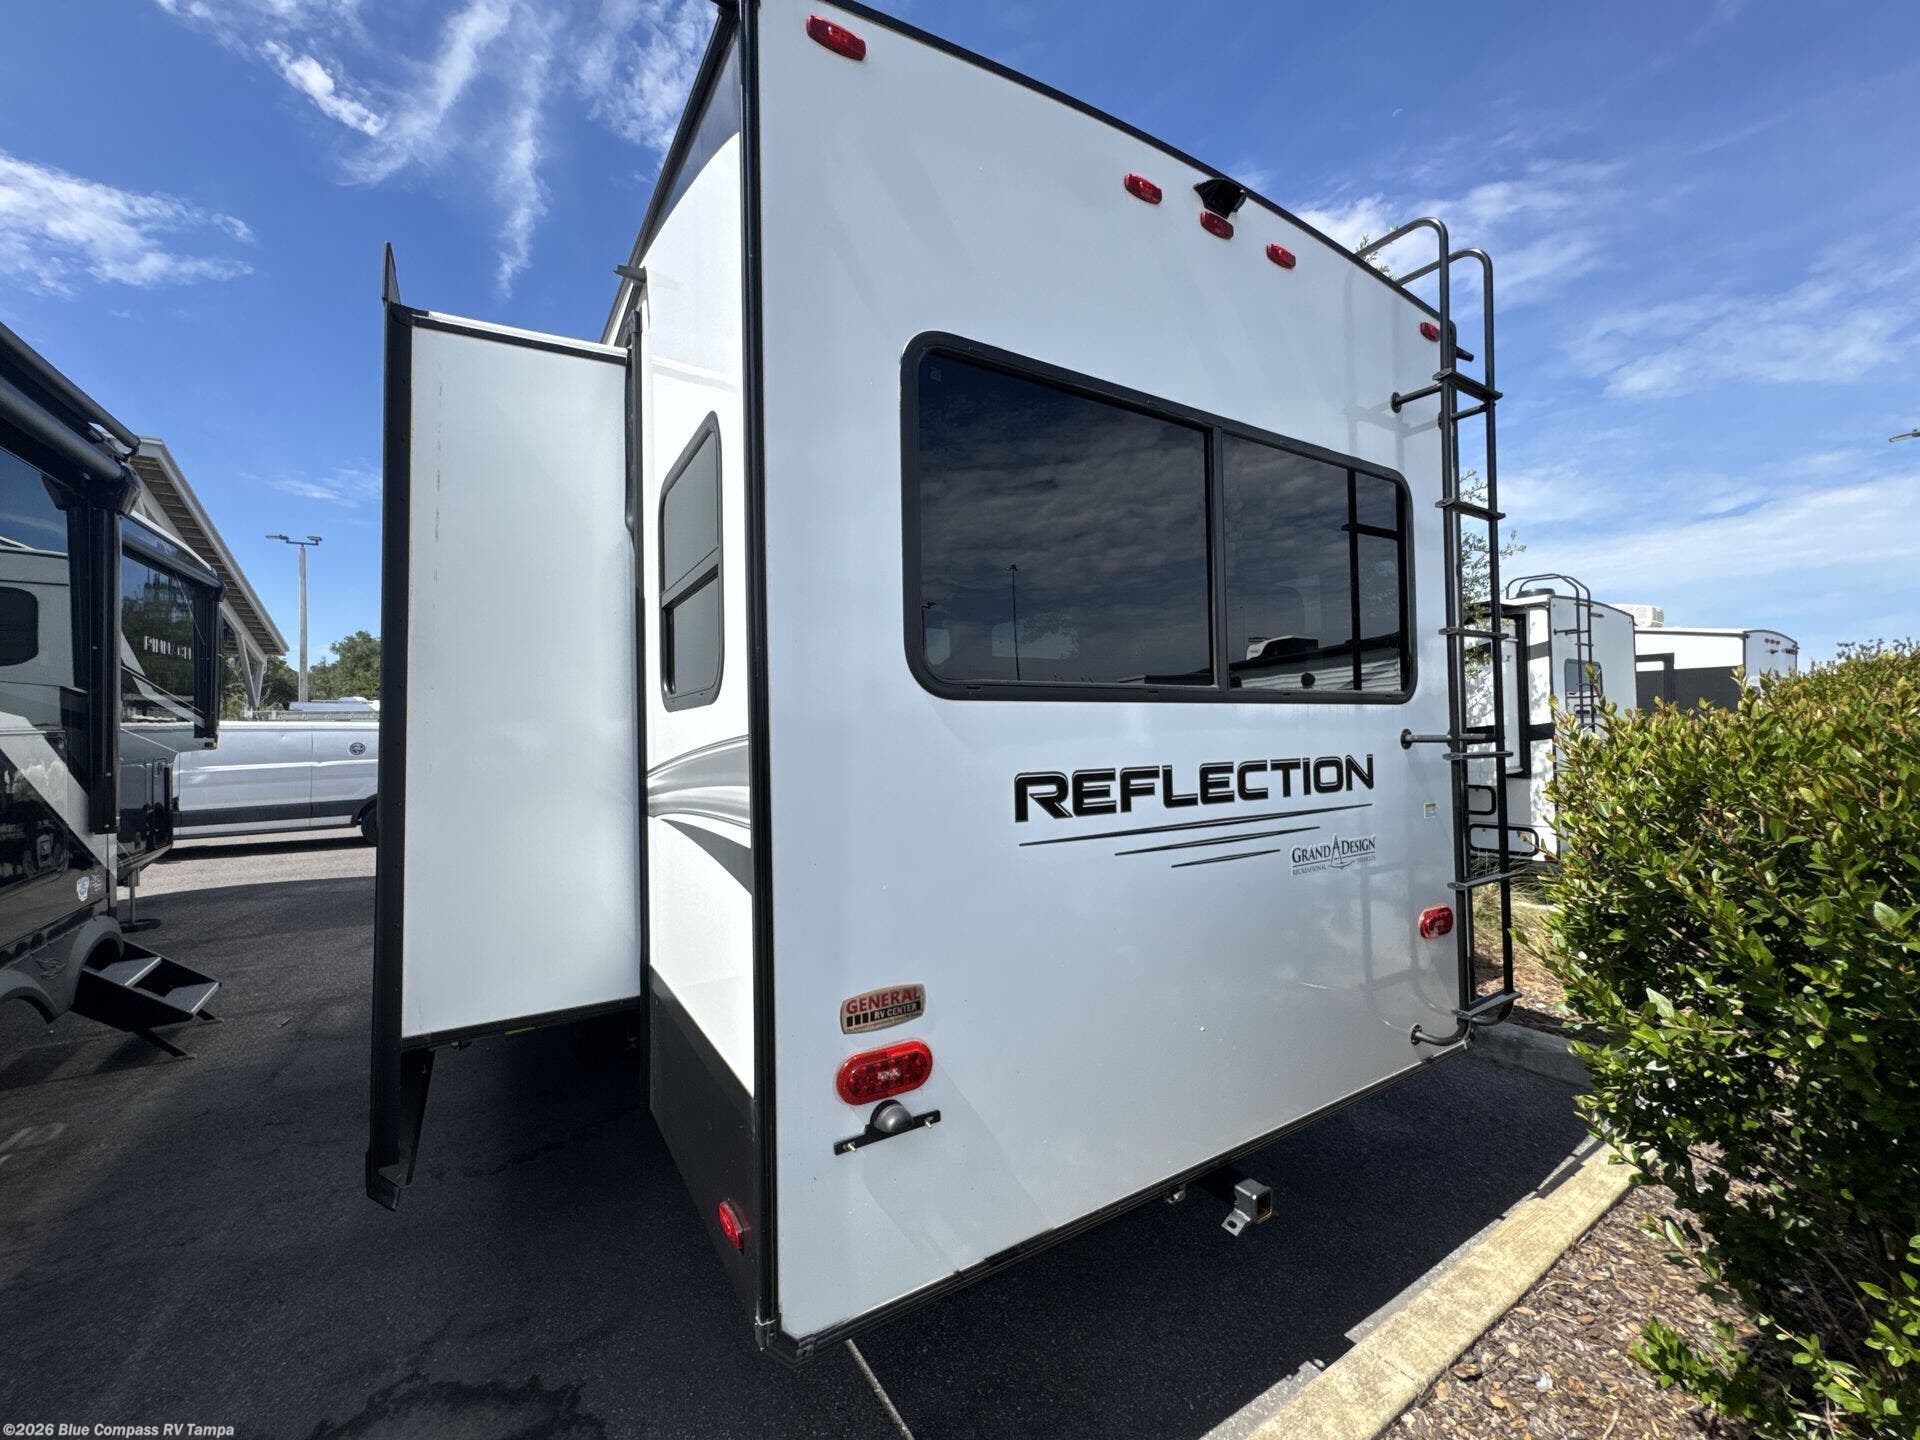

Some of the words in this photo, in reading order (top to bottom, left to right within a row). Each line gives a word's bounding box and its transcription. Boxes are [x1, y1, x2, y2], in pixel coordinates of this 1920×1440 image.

[1014, 753, 1374, 823] REFLECTION
[1292, 845, 1331, 863] GRAND
[1341, 837, 1376, 855] DESIGN
[846, 986, 920, 1014] GENERAL
[874, 1010, 886, 1020] RV
[887, 1002, 918, 1017] CENTER
